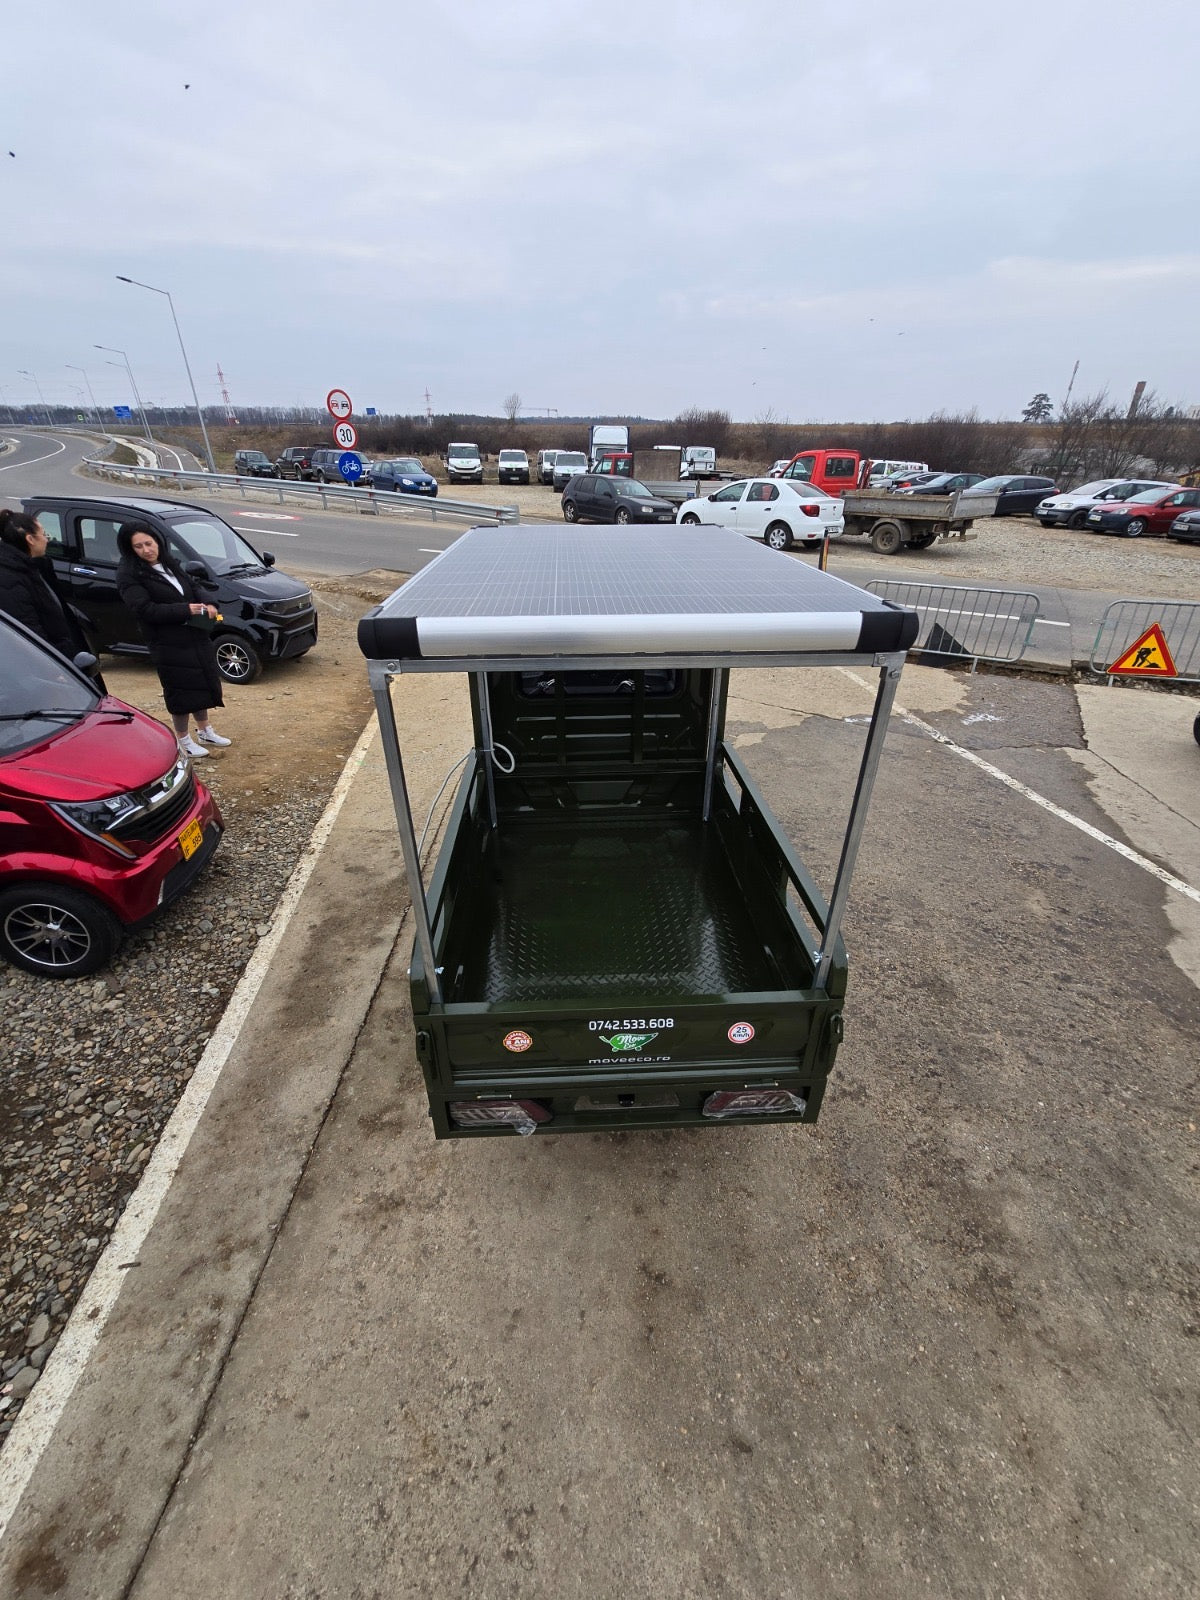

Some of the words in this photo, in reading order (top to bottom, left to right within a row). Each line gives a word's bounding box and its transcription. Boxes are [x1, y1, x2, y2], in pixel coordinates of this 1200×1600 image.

[340, 428, 352, 443] 30
[588, 1018, 674, 1031] 0742.533.608
[736, 1026, 748, 1034] 25
[588, 1056, 671, 1064] moveeco.ro
